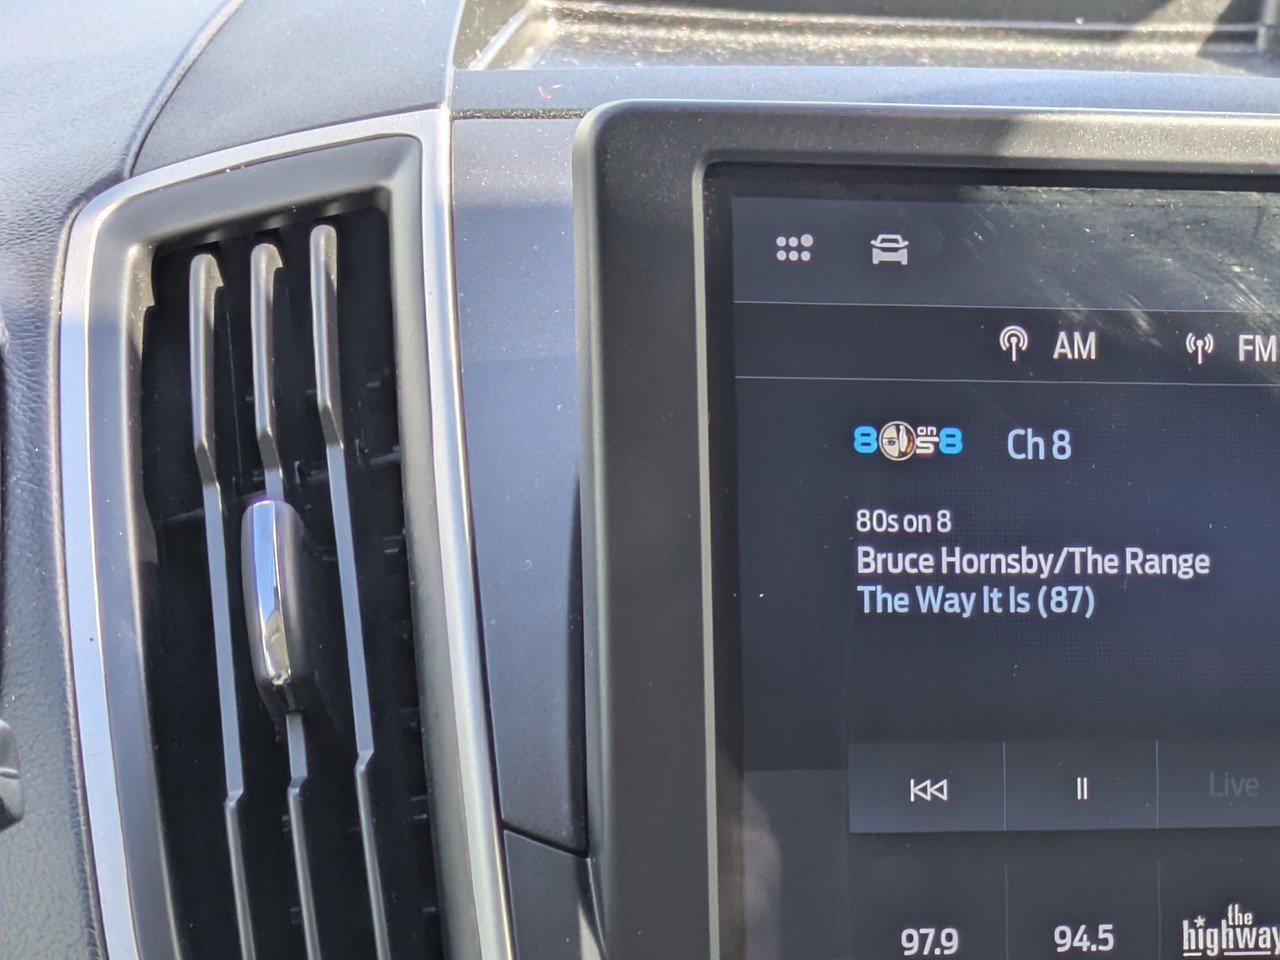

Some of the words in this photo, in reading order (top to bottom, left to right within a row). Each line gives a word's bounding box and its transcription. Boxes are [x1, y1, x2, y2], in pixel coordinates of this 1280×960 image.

[1052, 331, 1097, 361] AM
[1238, 334, 1278, 363] FM
[1007, 428, 1045, 460] Ch
[1051, 429, 1073, 461] 8
[855, 509, 900, 533] 80s
[902, 513, 932, 533] on
[936, 509, 952, 533] 8
[857, 545, 935, 575] Bruce
[941, 545, 1120, 579] Hornsby/The
[1125, 547, 1211, 579] Range
[856, 585, 910, 614] The
[914, 585, 977, 618] Way
[982, 585, 1003, 614] It
[1008, 585, 1031, 614] Is
[1036, 585, 1096, 619] (87)
[1208, 770, 1261, 799] Live
[1227, 903, 1253, 926] the
[900, 927, 960, 956] 97.9
[1053, 923, 1116, 953] 94.5
